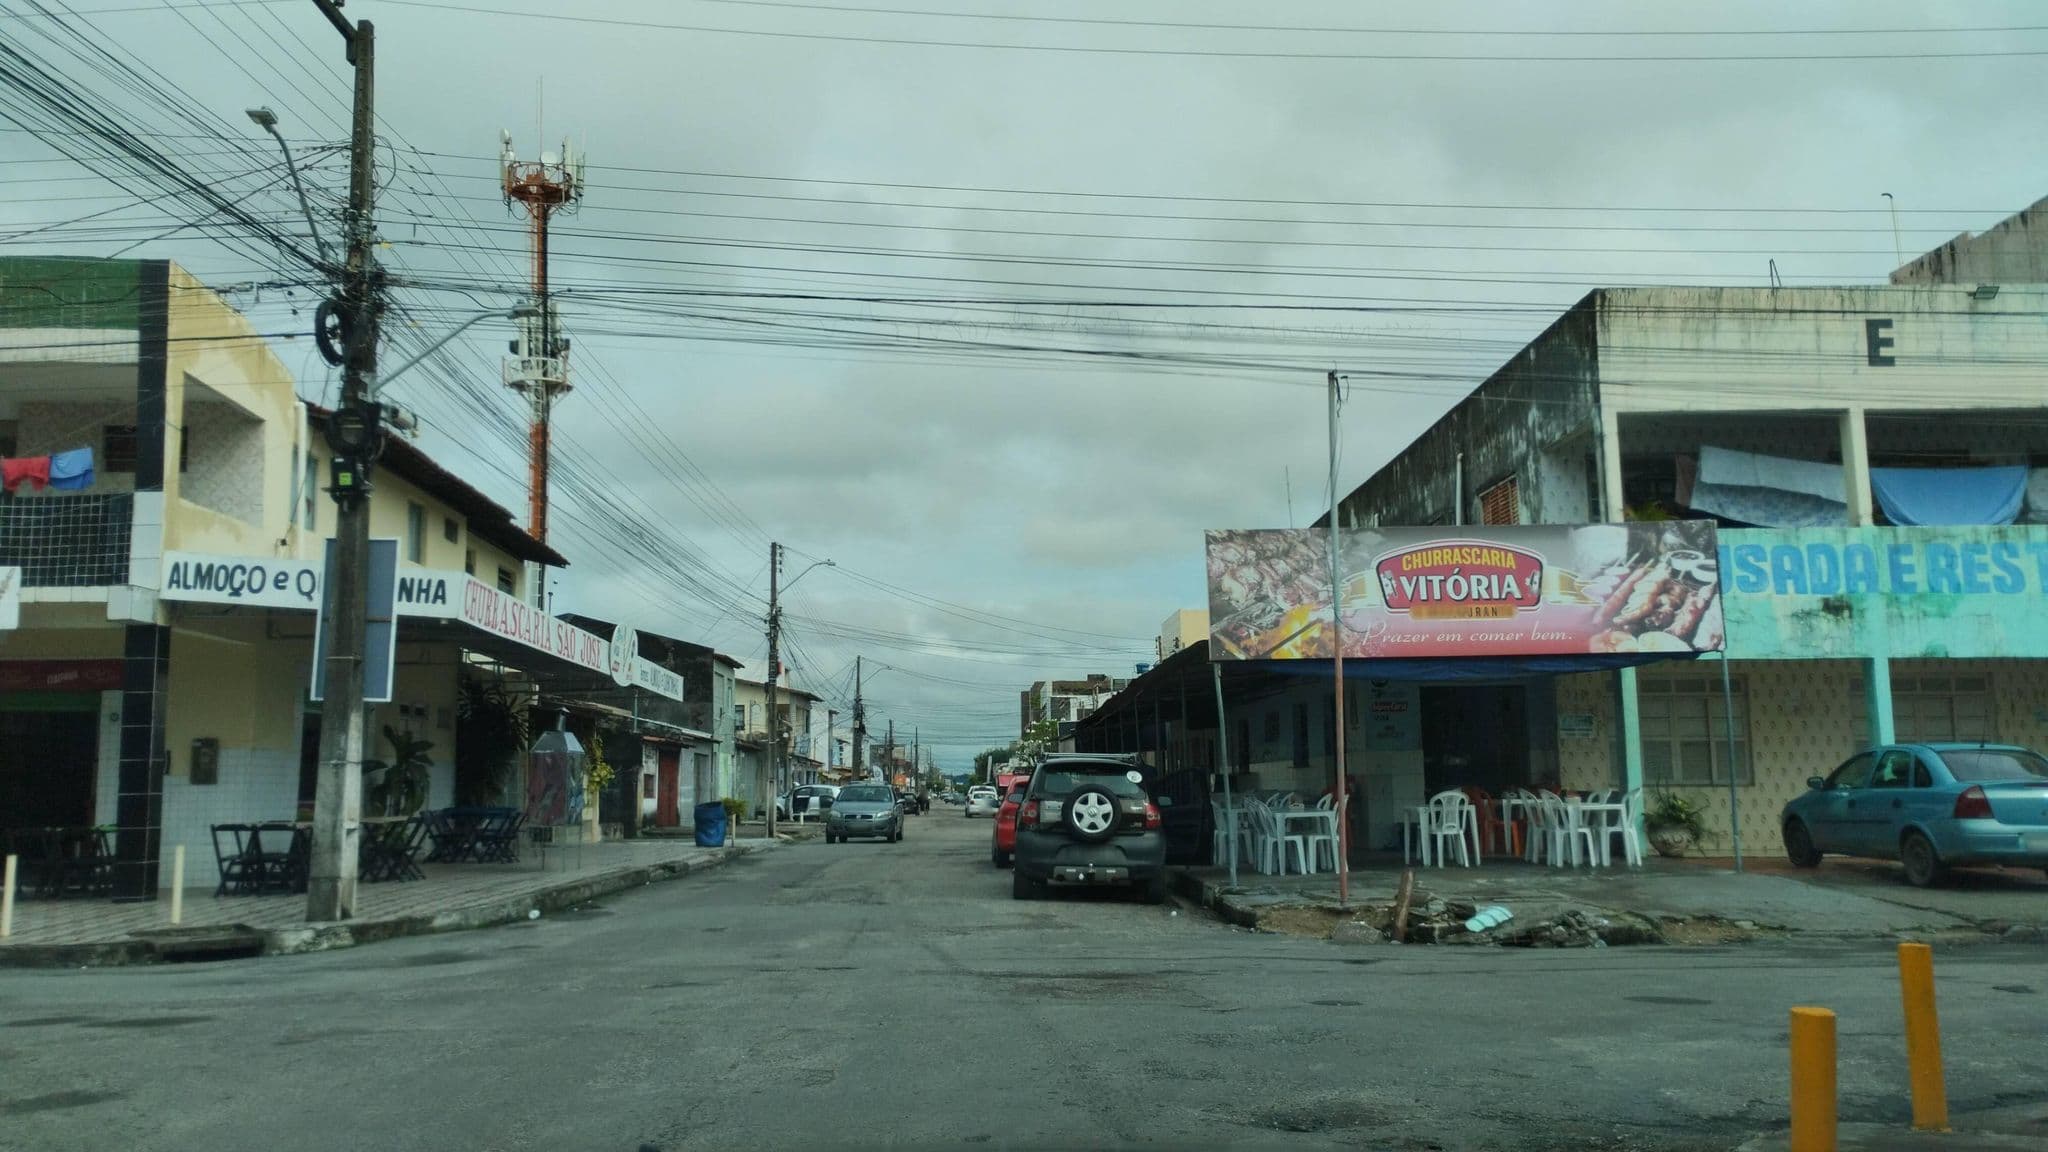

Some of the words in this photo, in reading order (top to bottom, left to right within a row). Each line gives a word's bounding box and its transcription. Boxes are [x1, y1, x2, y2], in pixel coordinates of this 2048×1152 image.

[1866, 319, 1895, 367] E
[1402, 547, 1516, 571] CHURRASCARIA
[1887, 543, 1918, 595] E
[168, 561, 267, 598] ALMOÇO
[273, 571, 289, 591] e
[1400, 568, 1522, 602] VITÓRIA
[464, 578, 552, 651] CHURRASCARIA
[1362, 621, 1430, 646] Prazer
[1437, 632, 1463, 643] em
[1470, 631, 1524, 643] comer
[1531, 620, 1573, 642] bem.
